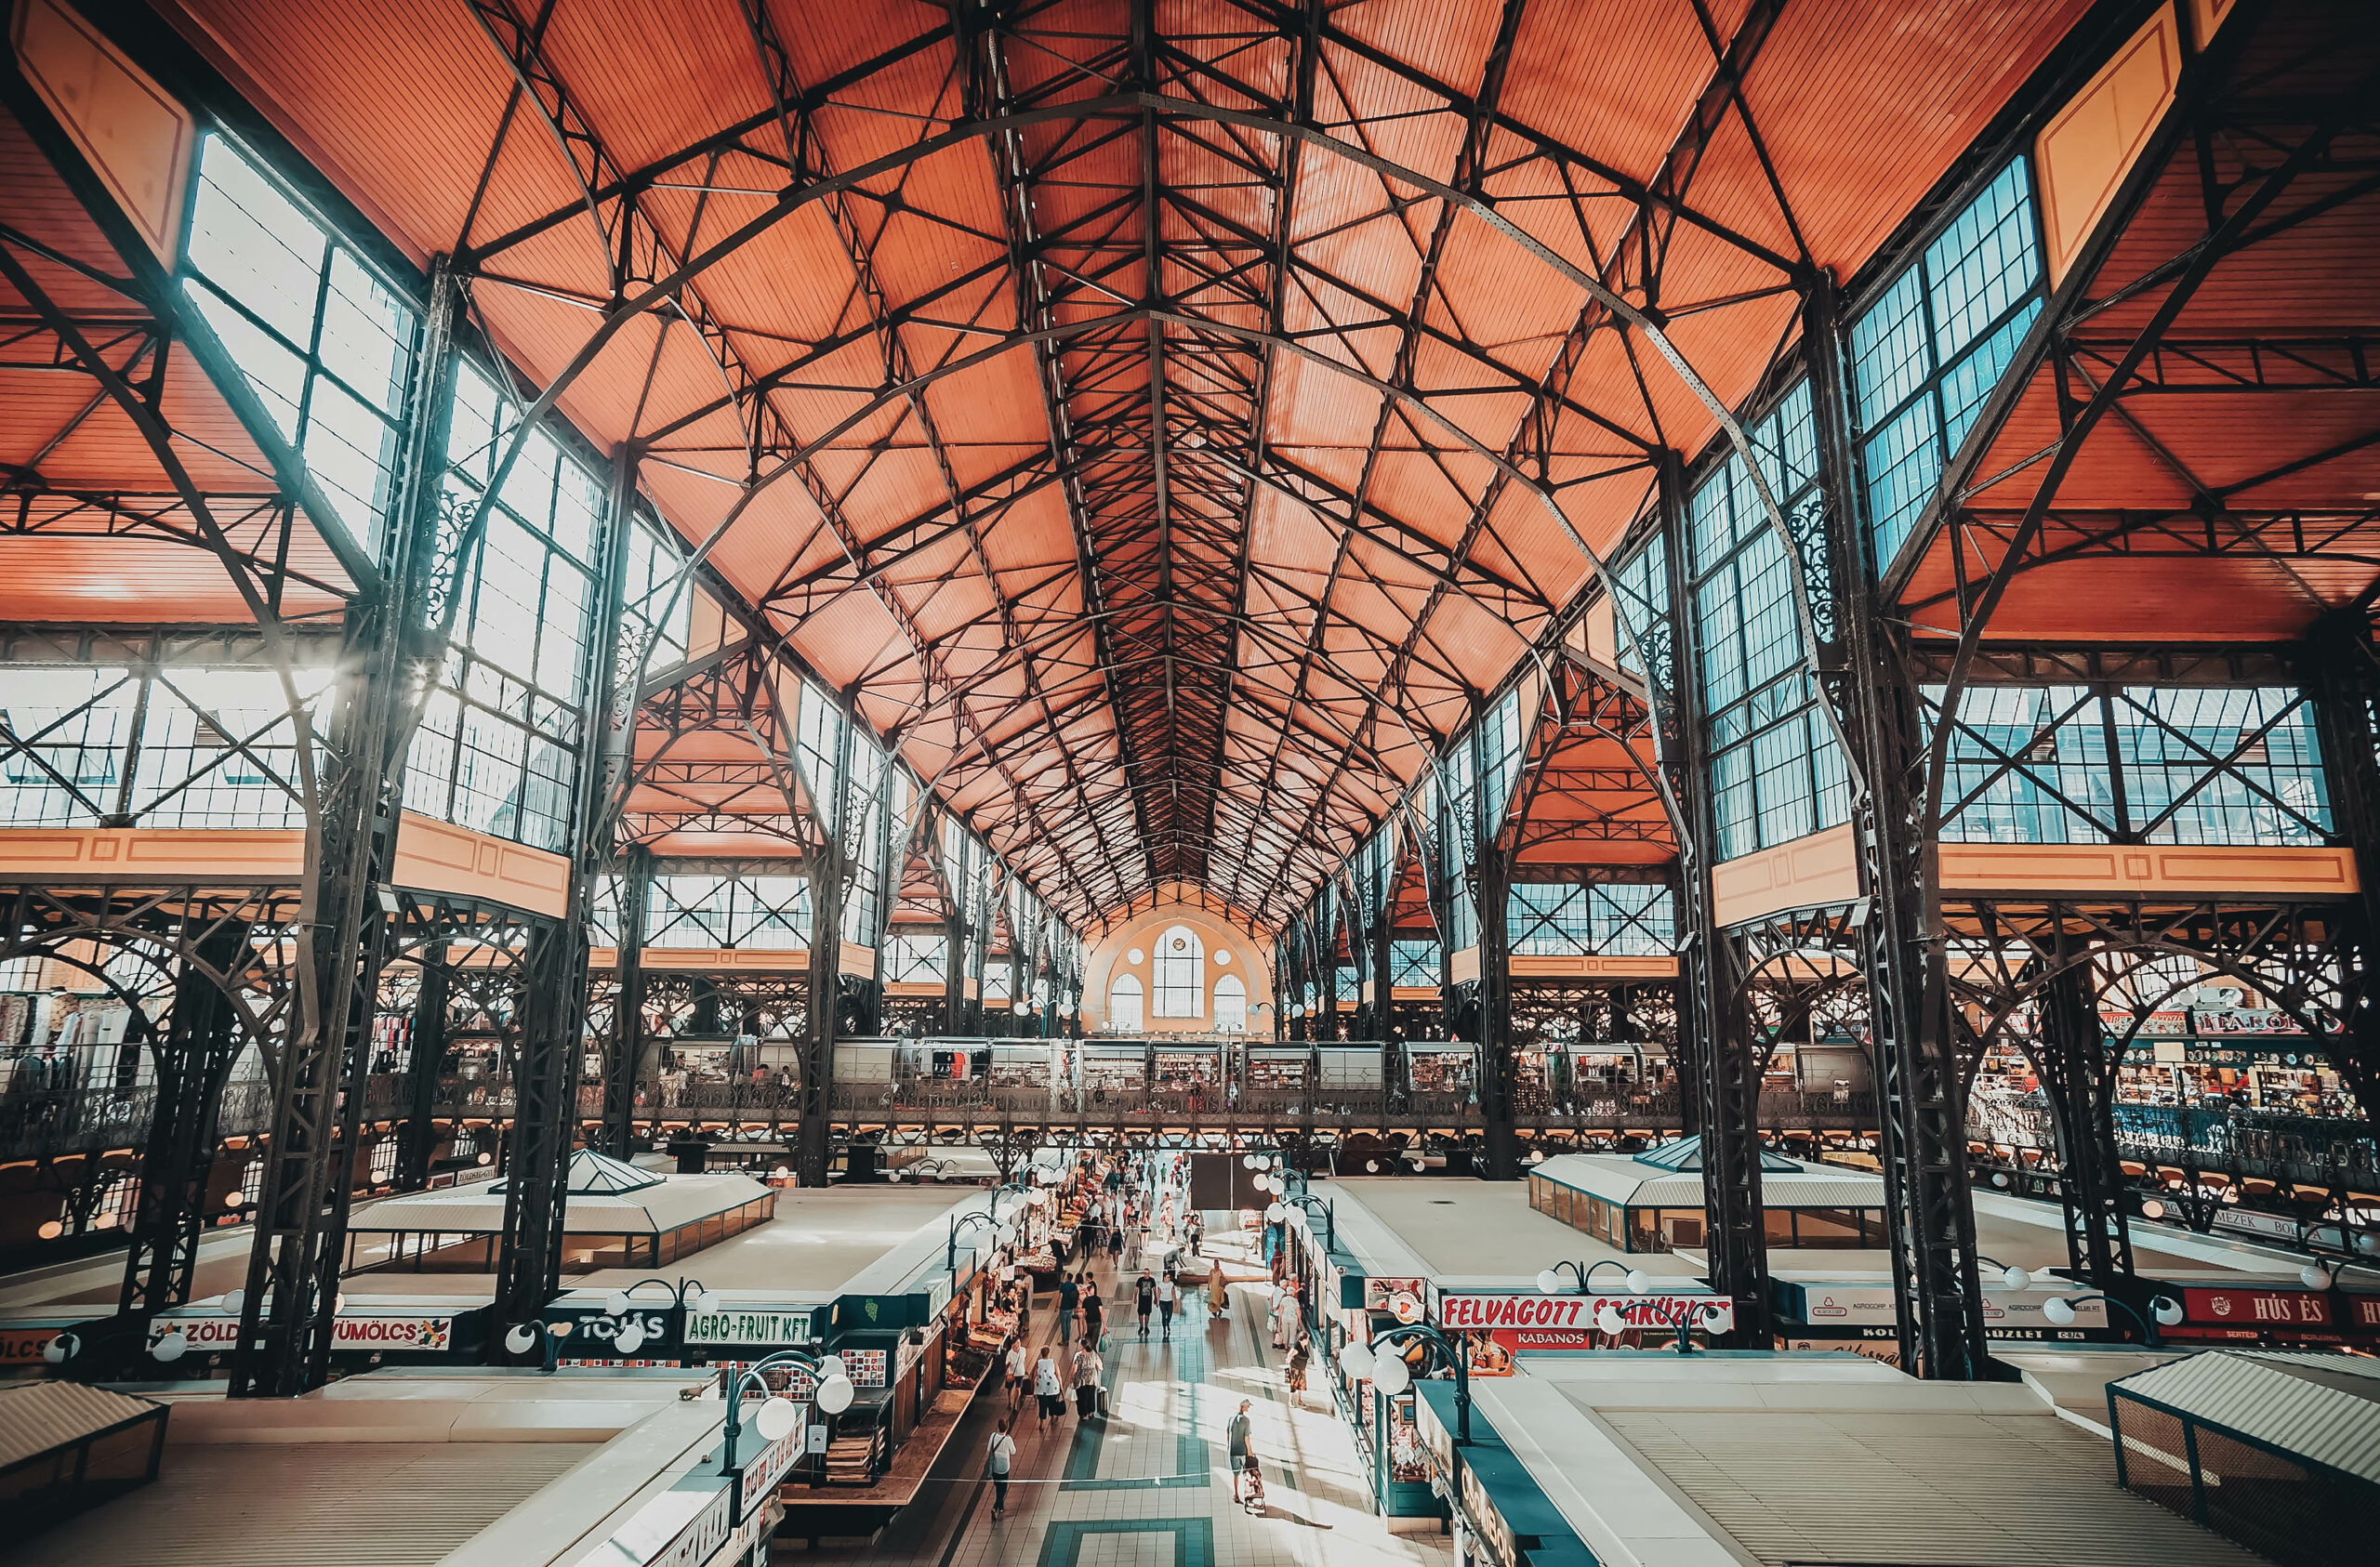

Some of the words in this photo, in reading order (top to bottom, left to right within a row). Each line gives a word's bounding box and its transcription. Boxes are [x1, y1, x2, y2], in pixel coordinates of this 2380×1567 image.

[1444, 1297, 1584, 1326] FELVÁGOTT
[2254, 1293, 2291, 1320] HÚS
[2298, 1295, 2323, 1322] ÉS
[689, 1314, 779, 1341] AGRO-FRUIT
[1517, 1333, 1585, 1344] KABANOS
